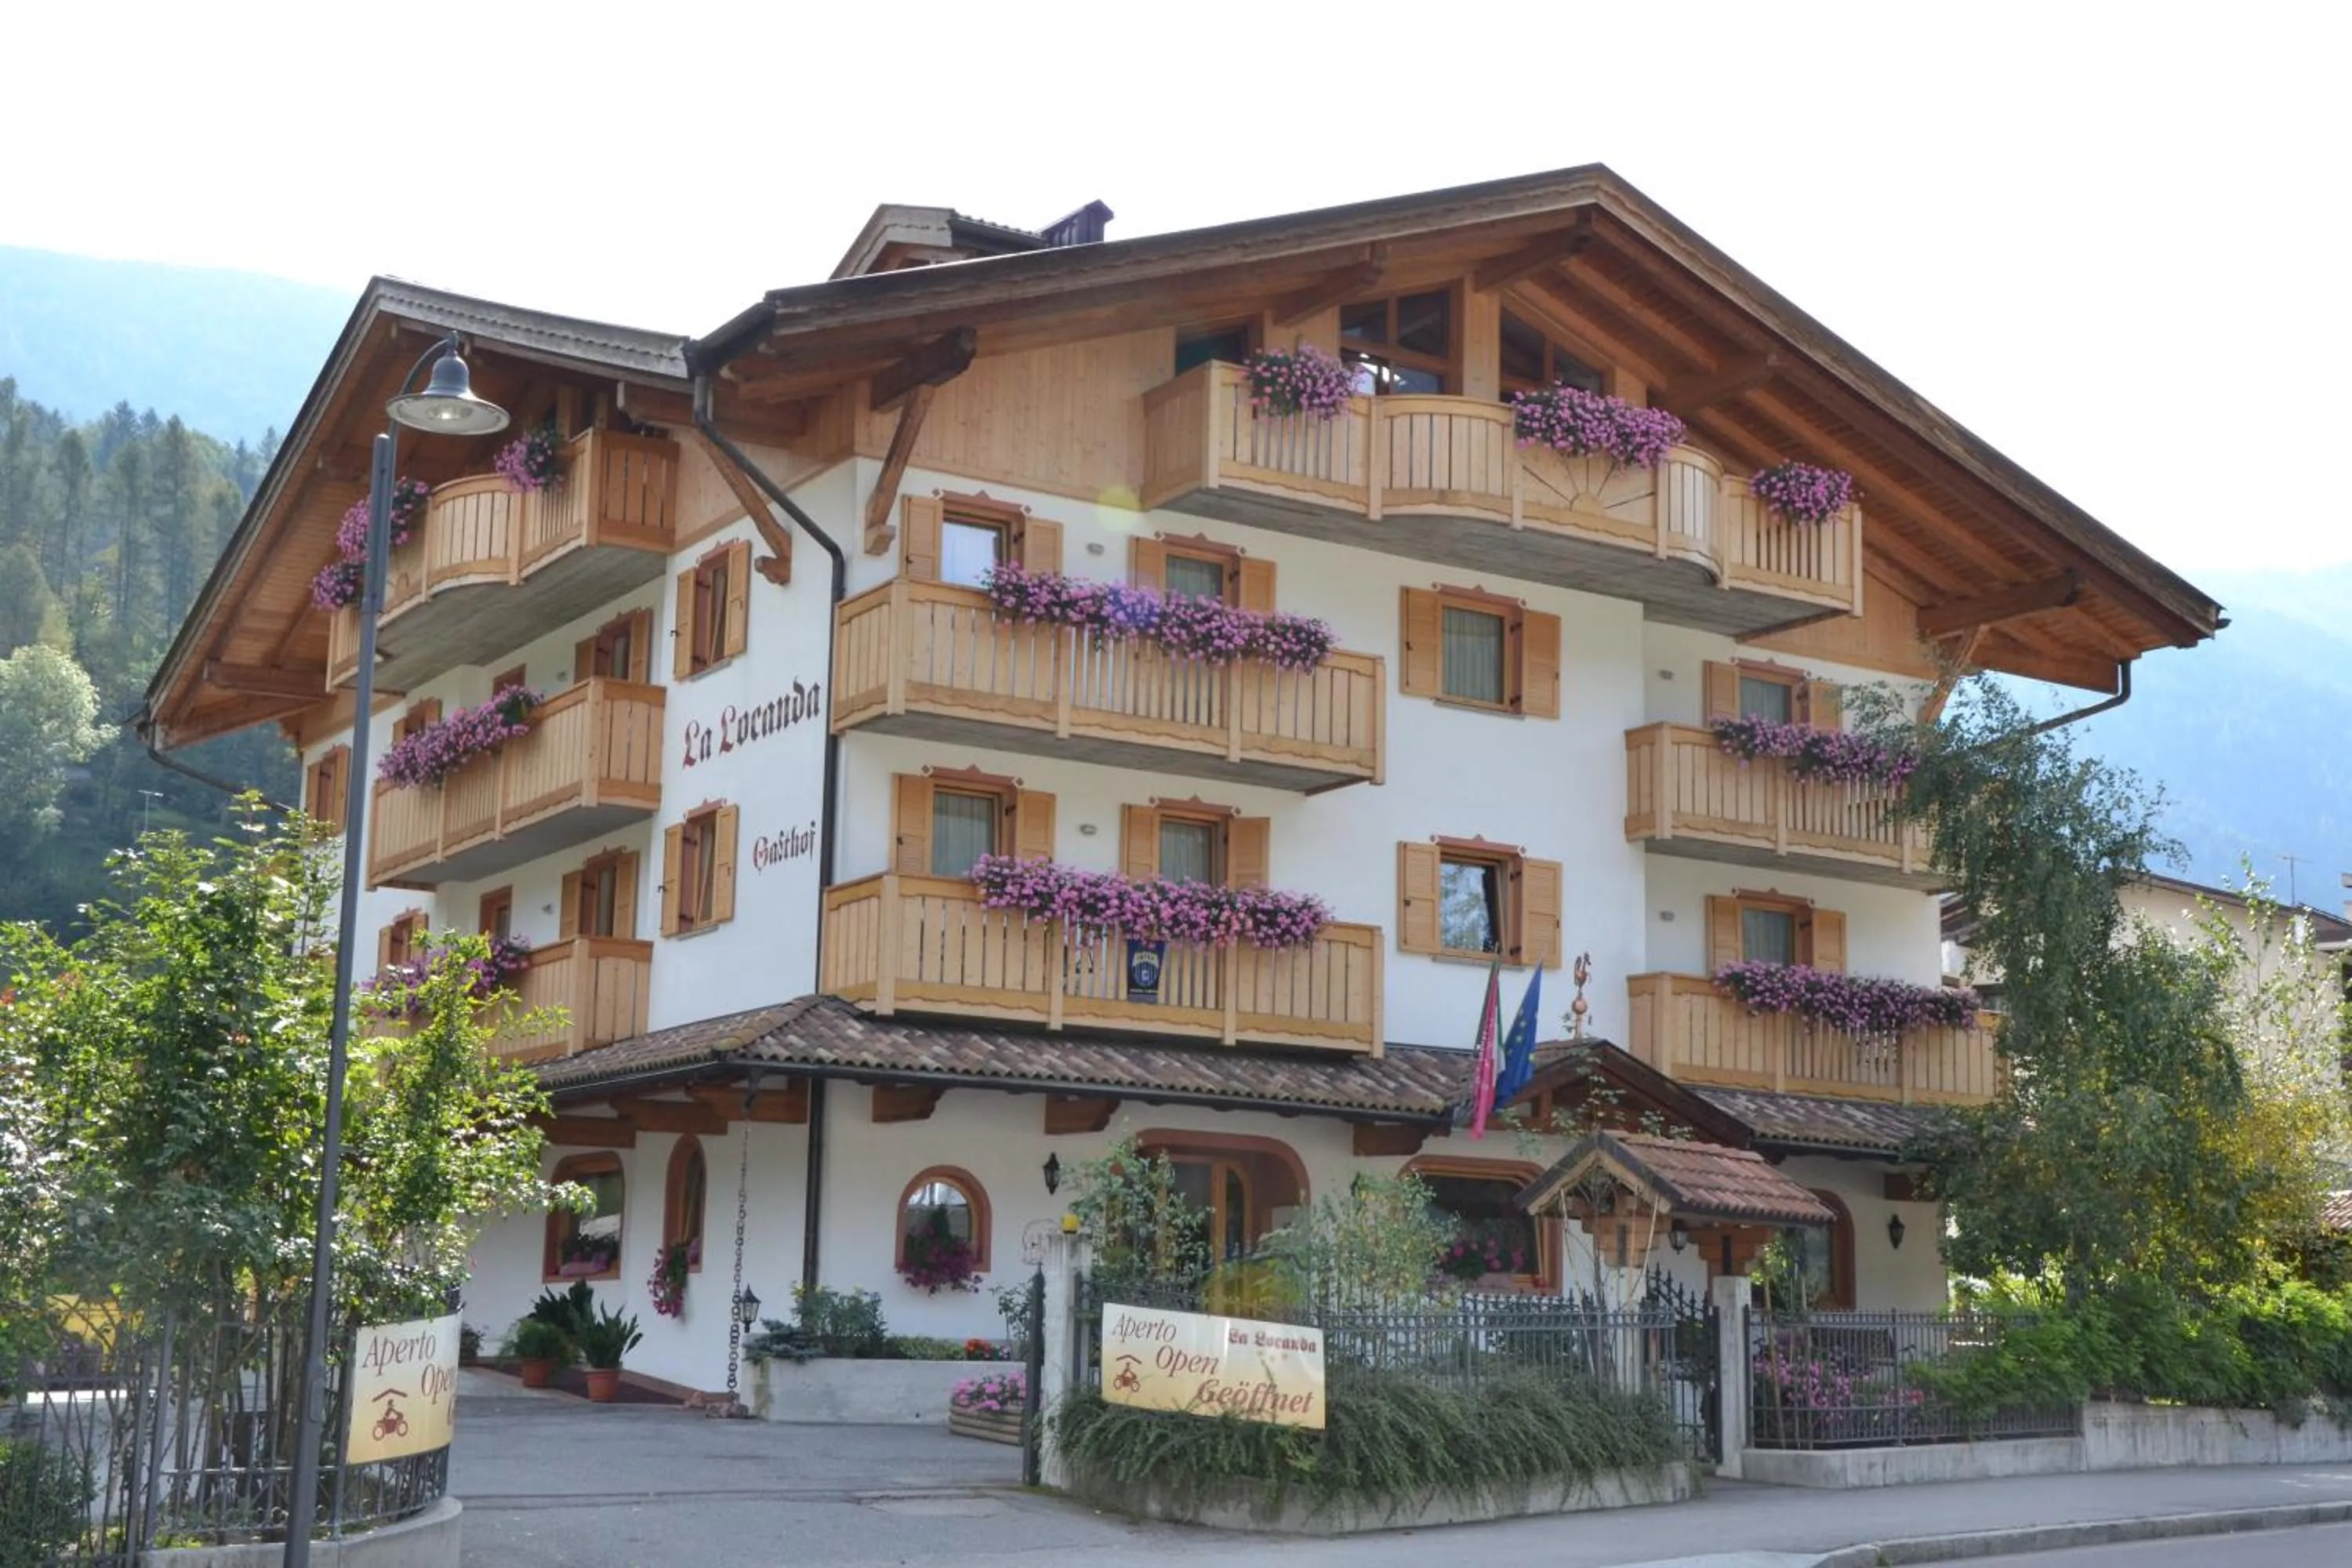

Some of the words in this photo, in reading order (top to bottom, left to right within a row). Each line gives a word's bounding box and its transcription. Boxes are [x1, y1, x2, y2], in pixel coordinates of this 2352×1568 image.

[683, 719, 712, 768] La
[719, 675, 820, 756] Locanda
[753, 820, 816, 875] Gasthof
[1112, 1312, 1177, 1343] Aperto
[1229, 1327, 1248, 1345] La
[1254, 1330, 1316, 1352] Locanda
[362, 1330, 437, 1376] Aperto
[1155, 1345, 1219, 1377] Open
[1196, 1379, 1315, 1418] Geöffnet
